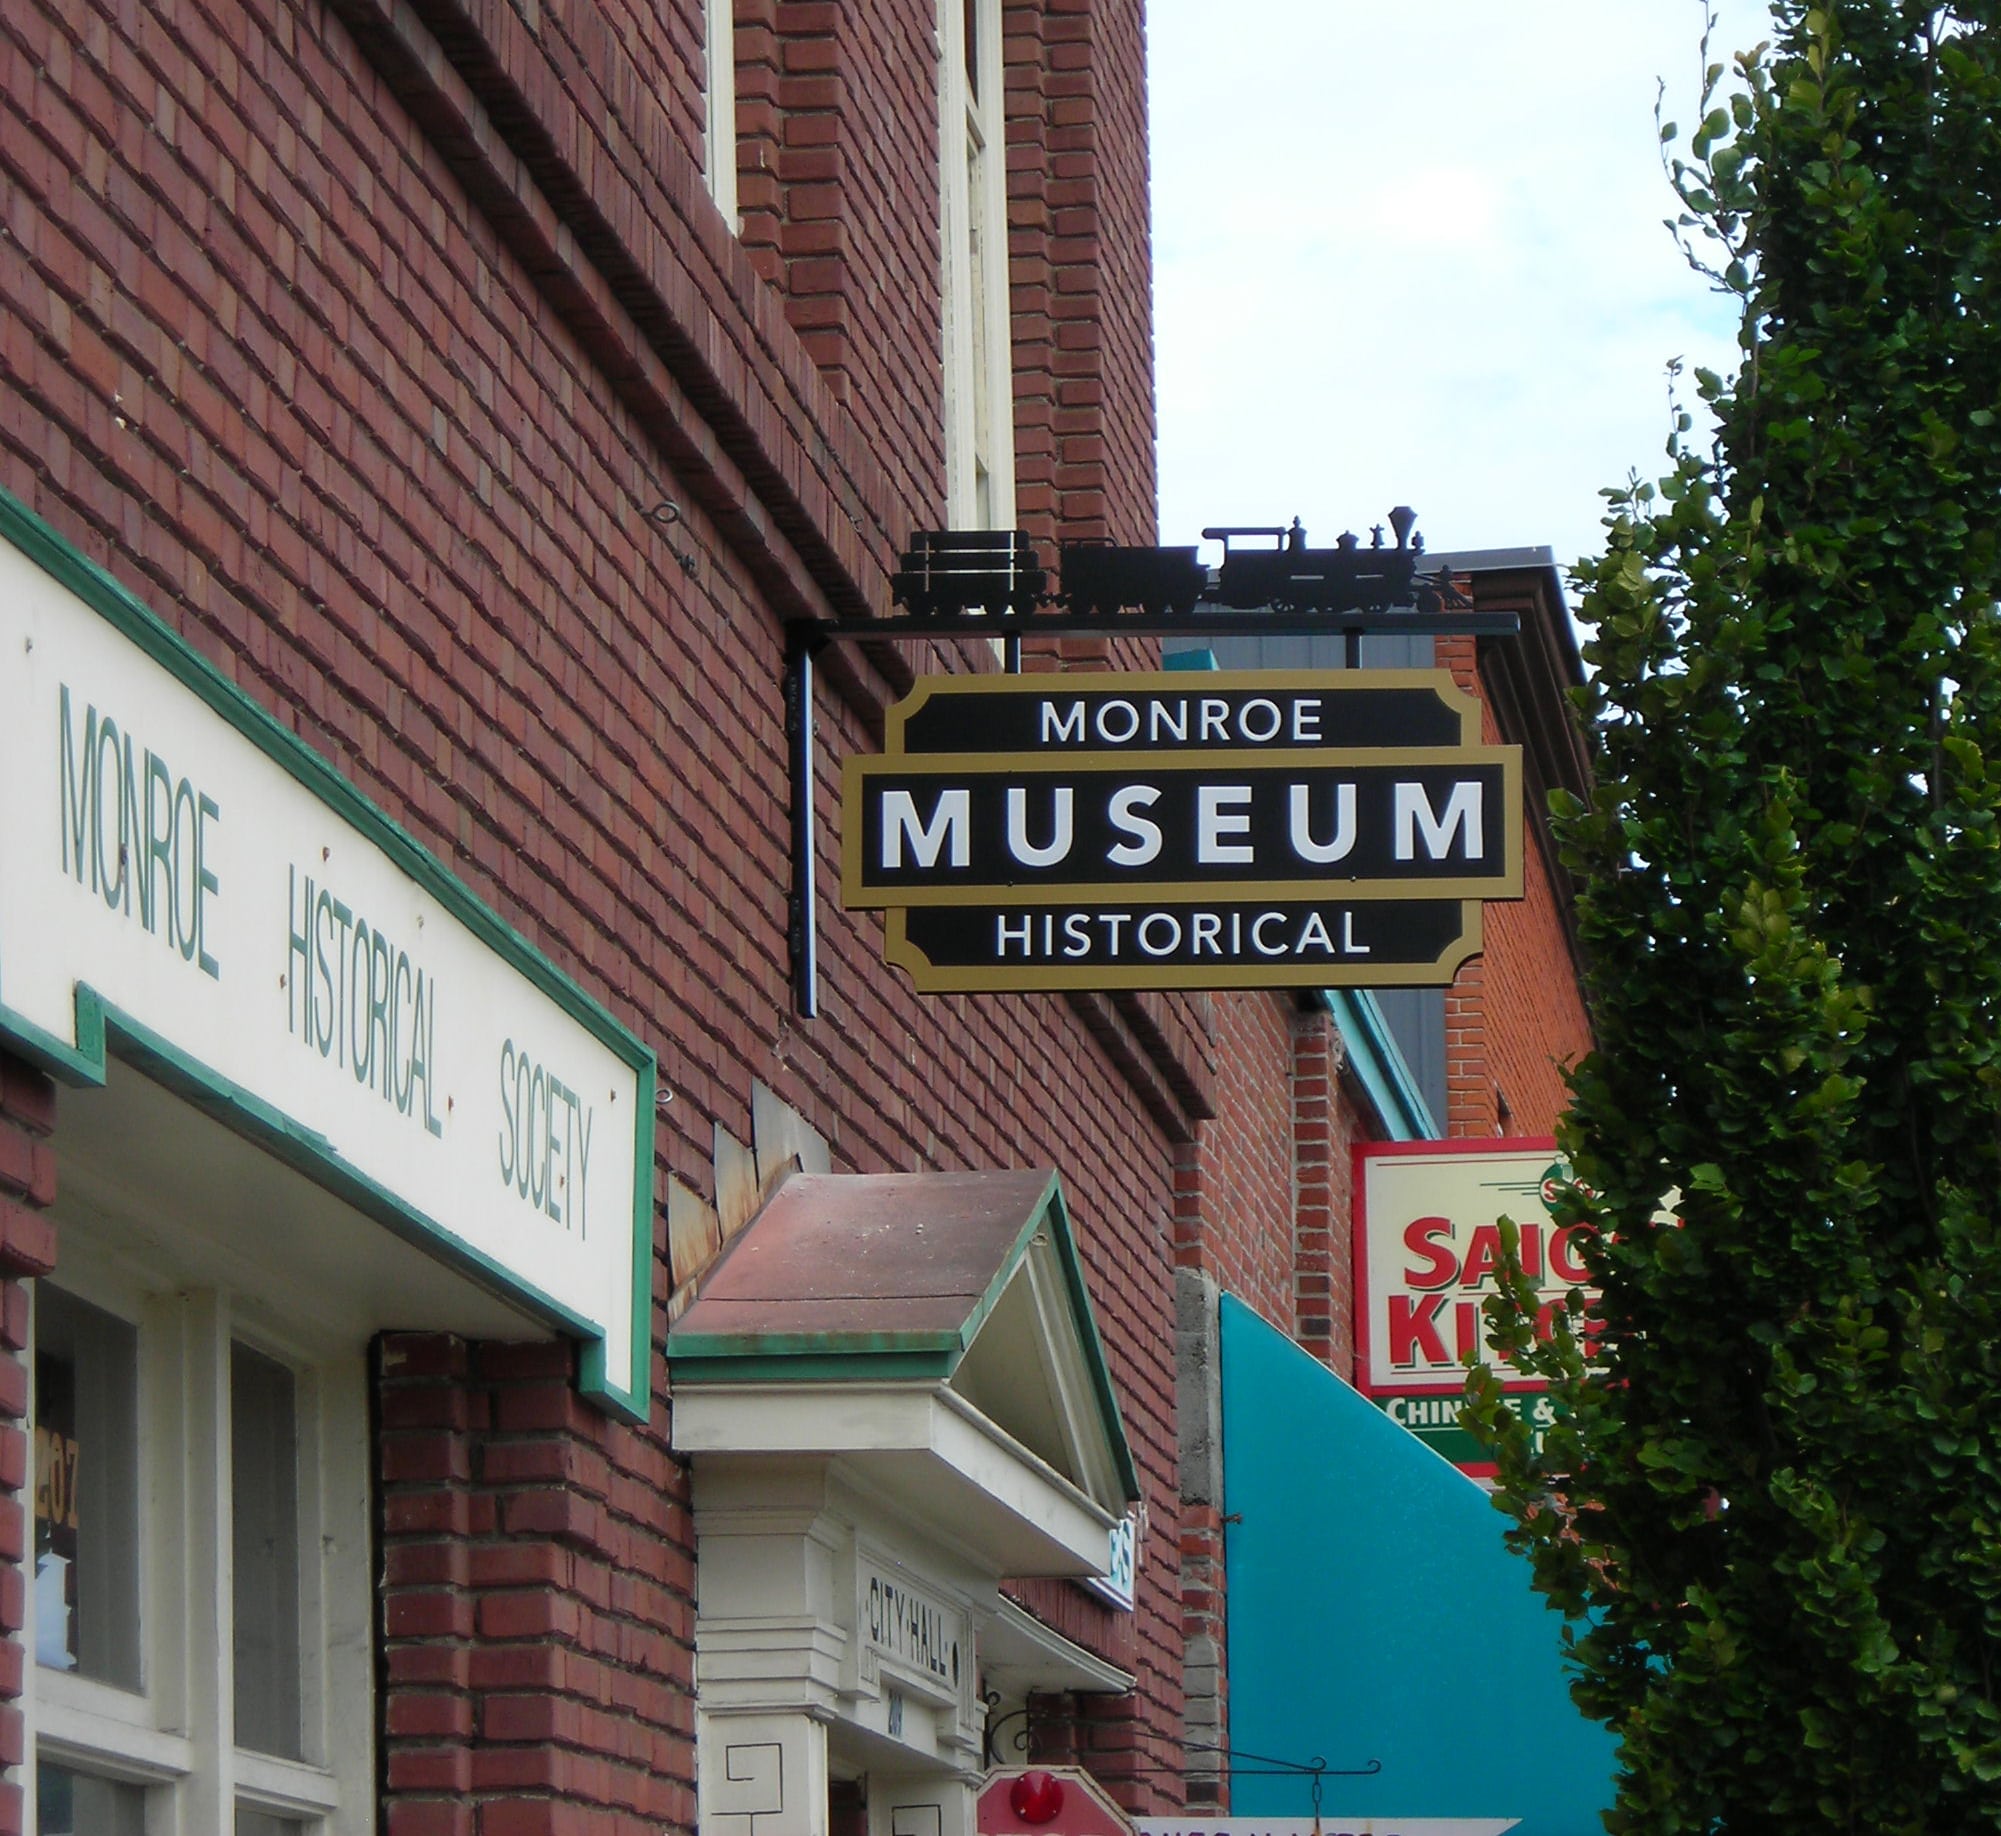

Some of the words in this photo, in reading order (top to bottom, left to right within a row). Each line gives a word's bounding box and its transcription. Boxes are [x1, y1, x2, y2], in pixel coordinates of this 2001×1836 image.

[1041, 699, 1322, 744] MONROE
[881, 781, 1484, 869] MUSEUM
[59, 682, 220, 982] MONROE
[288, 862, 442, 1139] HISTORICAL
[499, 1037, 593, 1241] SOCIETY
[996, 912, 1371, 957] HISTORICAL
[1403, 1216, 1625, 1291] SAIG
[1386, 1397, 1521, 1426] CHINE
[870, 1576, 905, 1654] CITY
[910, 1598, 946, 1677] HALL
